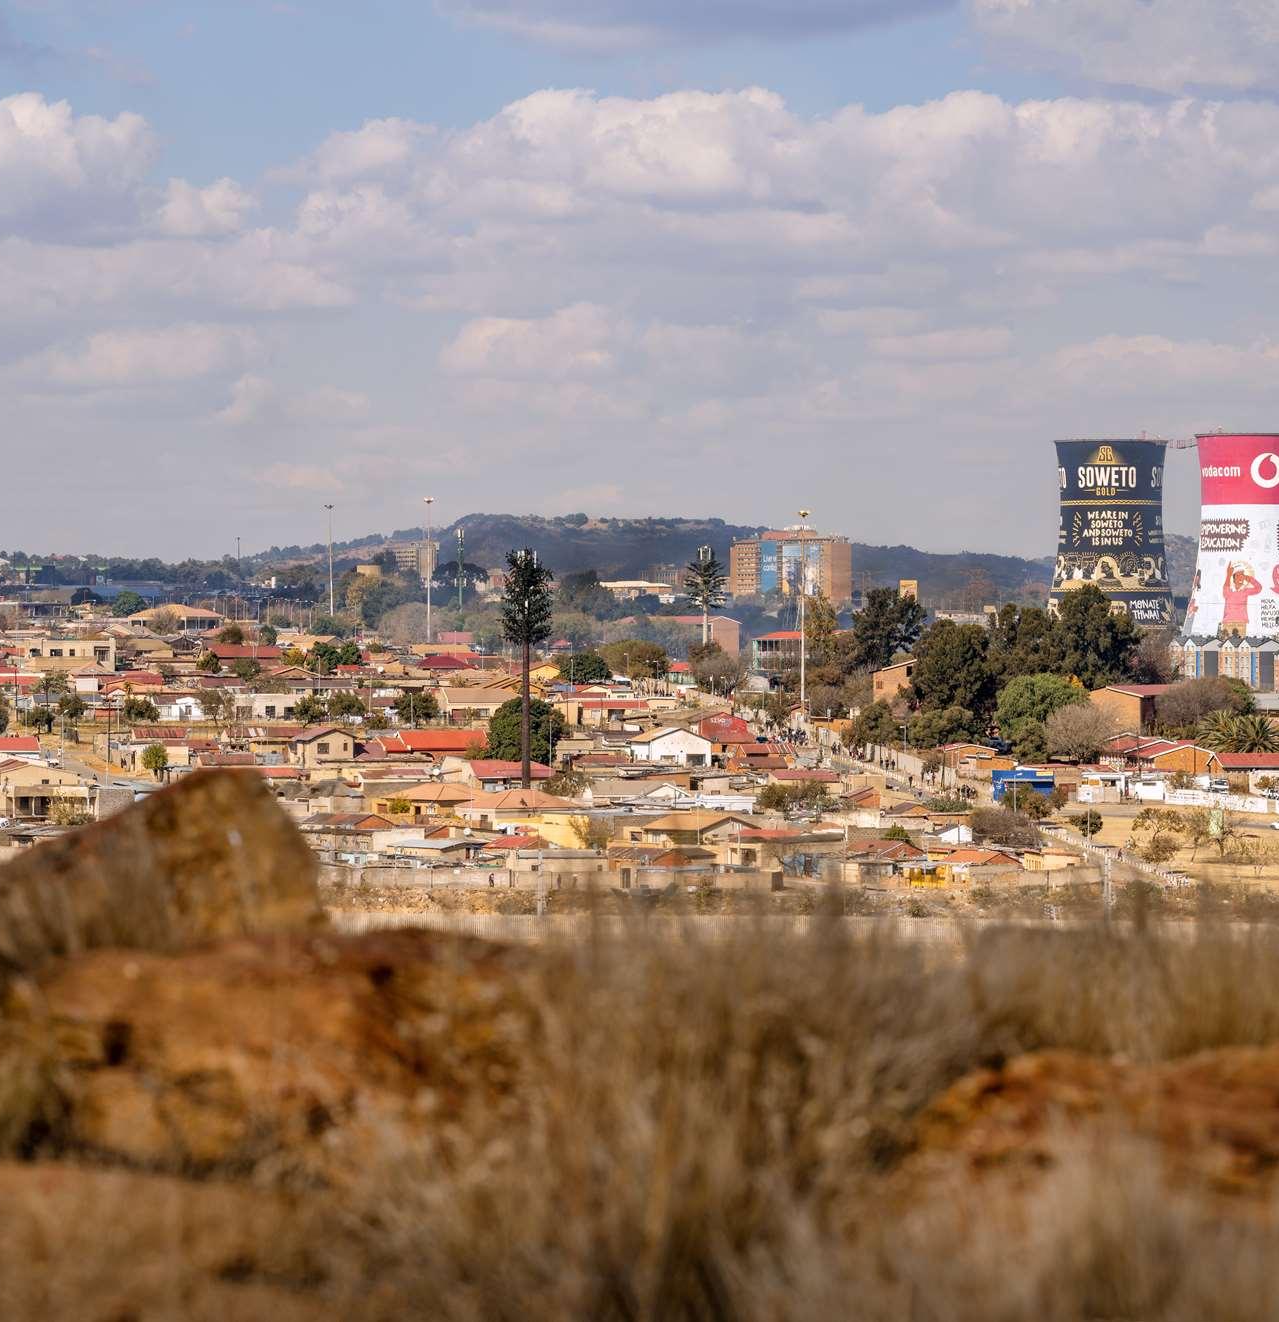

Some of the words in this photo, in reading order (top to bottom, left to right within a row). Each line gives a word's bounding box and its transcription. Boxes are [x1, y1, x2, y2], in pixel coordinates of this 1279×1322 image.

[1201, 466, 1241, 477] vodacom
[1077, 466, 1137, 488] SOWETO
[1096, 487, 1116, 496] GOLD
[1087, 511, 1100, 519] WE
[1100, 511, 1117, 519] ARE
[1118, 511, 1128, 519] IN
[1090, 520, 1123, 528] SOWETO
[1082, 529, 1100, 537] AND
[1101, 529, 1133, 537] SOWETO
